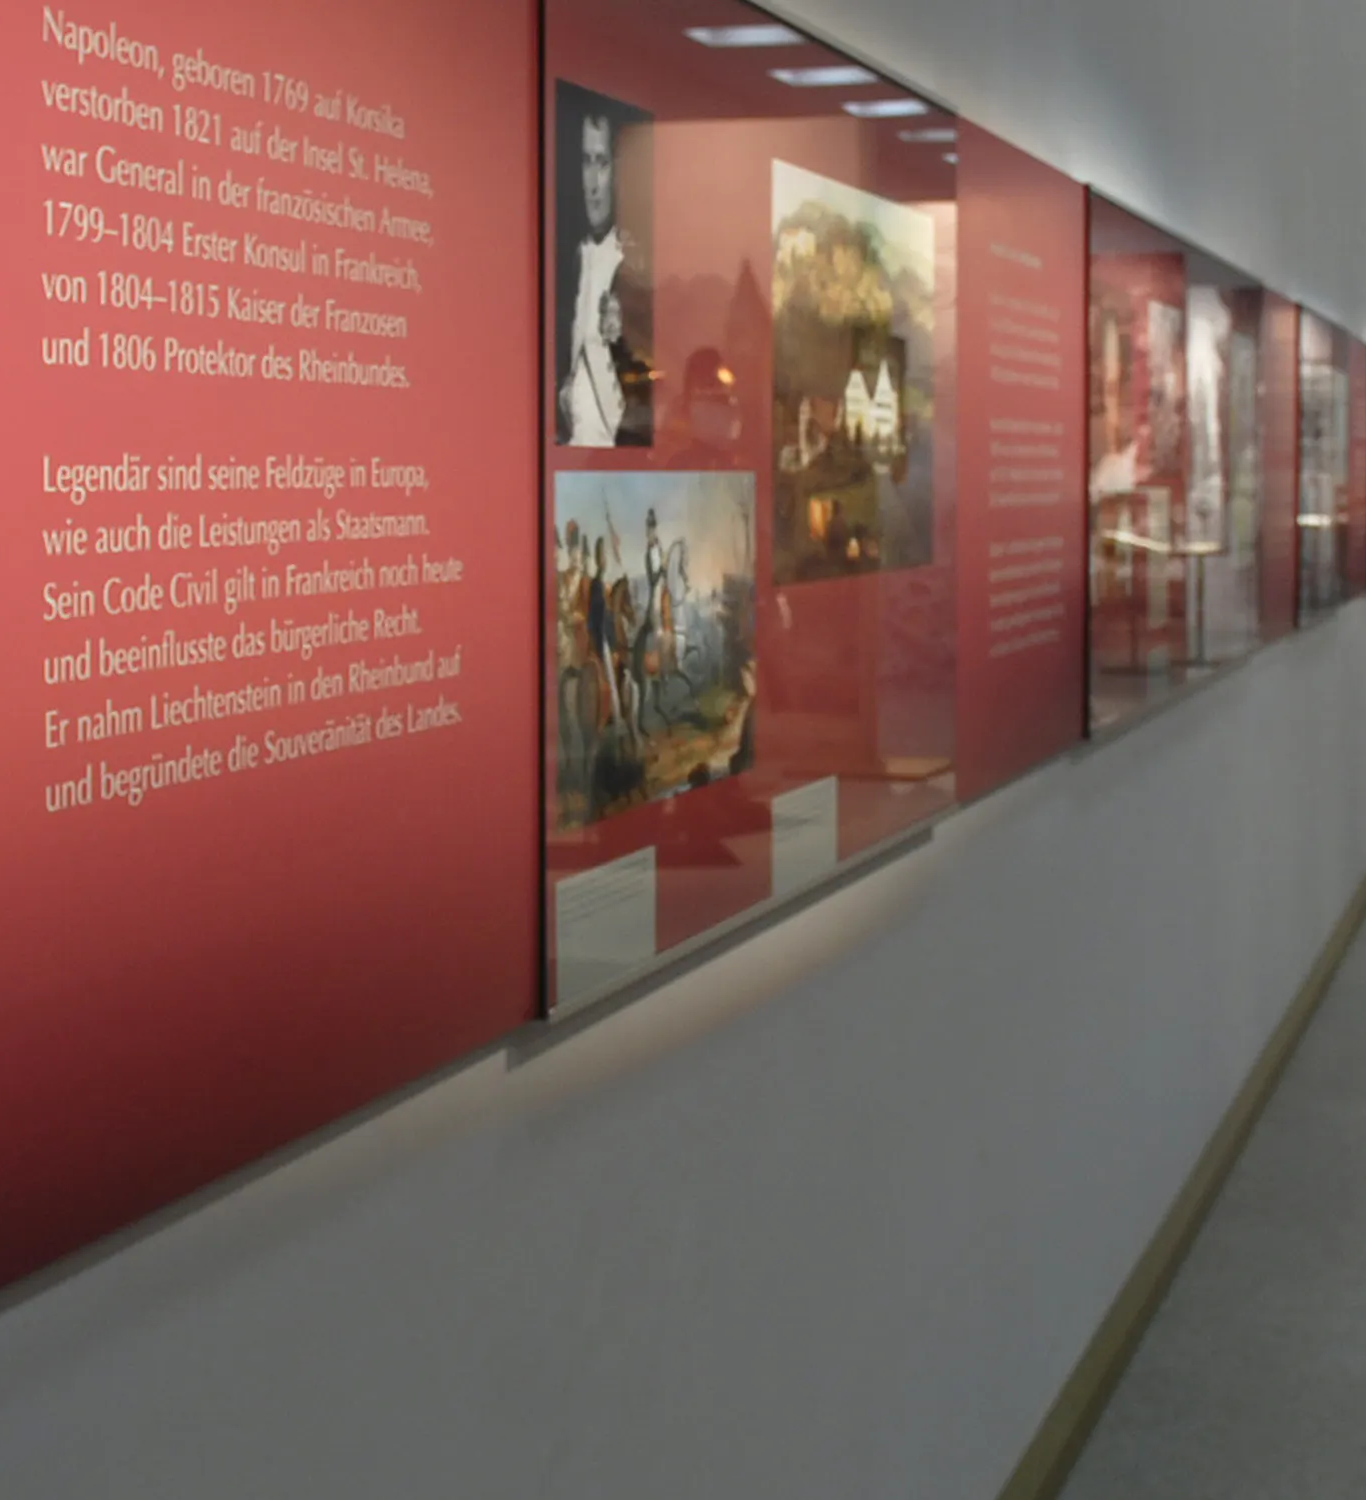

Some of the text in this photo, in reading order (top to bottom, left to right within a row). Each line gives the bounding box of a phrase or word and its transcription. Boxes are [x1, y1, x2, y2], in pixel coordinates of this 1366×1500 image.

[43, 6, 405, 138] Napoleon, geboren 1769 auf Korsika
[42, 79, 163, 132] verstorben
[173, 105, 221, 145] 1821
[231, 122, 261, 154] auf
[267, 126, 297, 163] der
[303, 137, 342, 175] Insel
[349, 148, 368, 181] St.
[41, 144, 87, 176] war
[96, 145, 183, 195] General
[192, 165, 211, 202] in
[218, 171, 249, 208] der
[257, 178, 374, 232] französischen
[183, 222, 236, 263] Erster
[244, 233, 305, 273] Konsul
[312, 243, 328, 277] in
[42, 271, 87, 303] von
[227, 287, 283, 324] Kaiser
[291, 294, 319, 329] der
[325, 300, 407, 338] Franzosen
[42, 327, 410, 388] und 1806 Protektor des Rheinbundes.
[44, 453, 429, 505] Legendär sind seine Feldzüge in Europa,
[43, 508, 430, 555] wie auch die Leistungen als Staatsmann.
[43, 553, 463, 620] Sein Code Civil gilt in Frankreich noch heute
[45, 604, 421, 684] und beeinflusste das bürgerliche Recht.
[45, 644, 461, 748] Er nahm Liechtenstein in den Rheinbund auf
[46, 695, 461, 812] und begründete die Souveränität des Landes.
